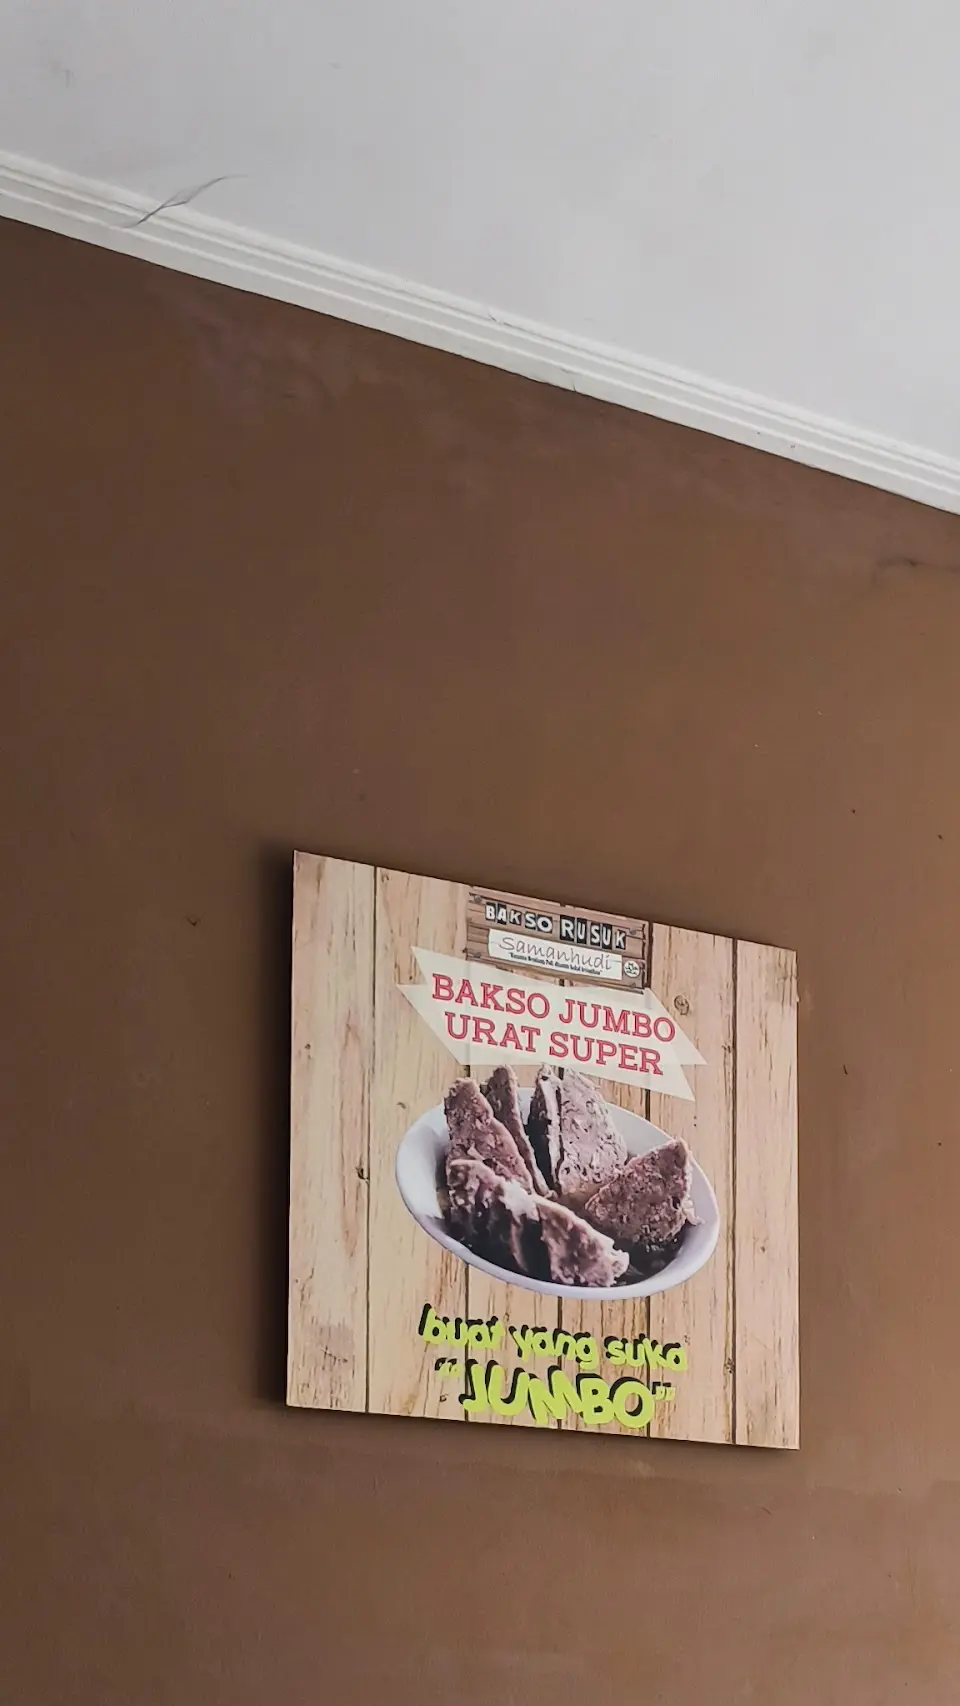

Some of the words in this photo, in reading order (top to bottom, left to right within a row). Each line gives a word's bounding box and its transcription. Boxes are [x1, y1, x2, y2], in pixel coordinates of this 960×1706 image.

[485, 903, 552, 933] BAKSO
[560, 916, 626, 950] RUSUK
[499, 936, 611, 971] Samanhudi
[432, 973, 549, 1019] BAKSO
[559, 998, 675, 1043] JUMBO
[444, 1011, 541, 1053] URAT
[549, 1031, 664, 1076] SUPER
[419, 1304, 504, 1349] buat
[509, 1325, 600, 1371] yang
[604, 1333, 688, 1372] suka
